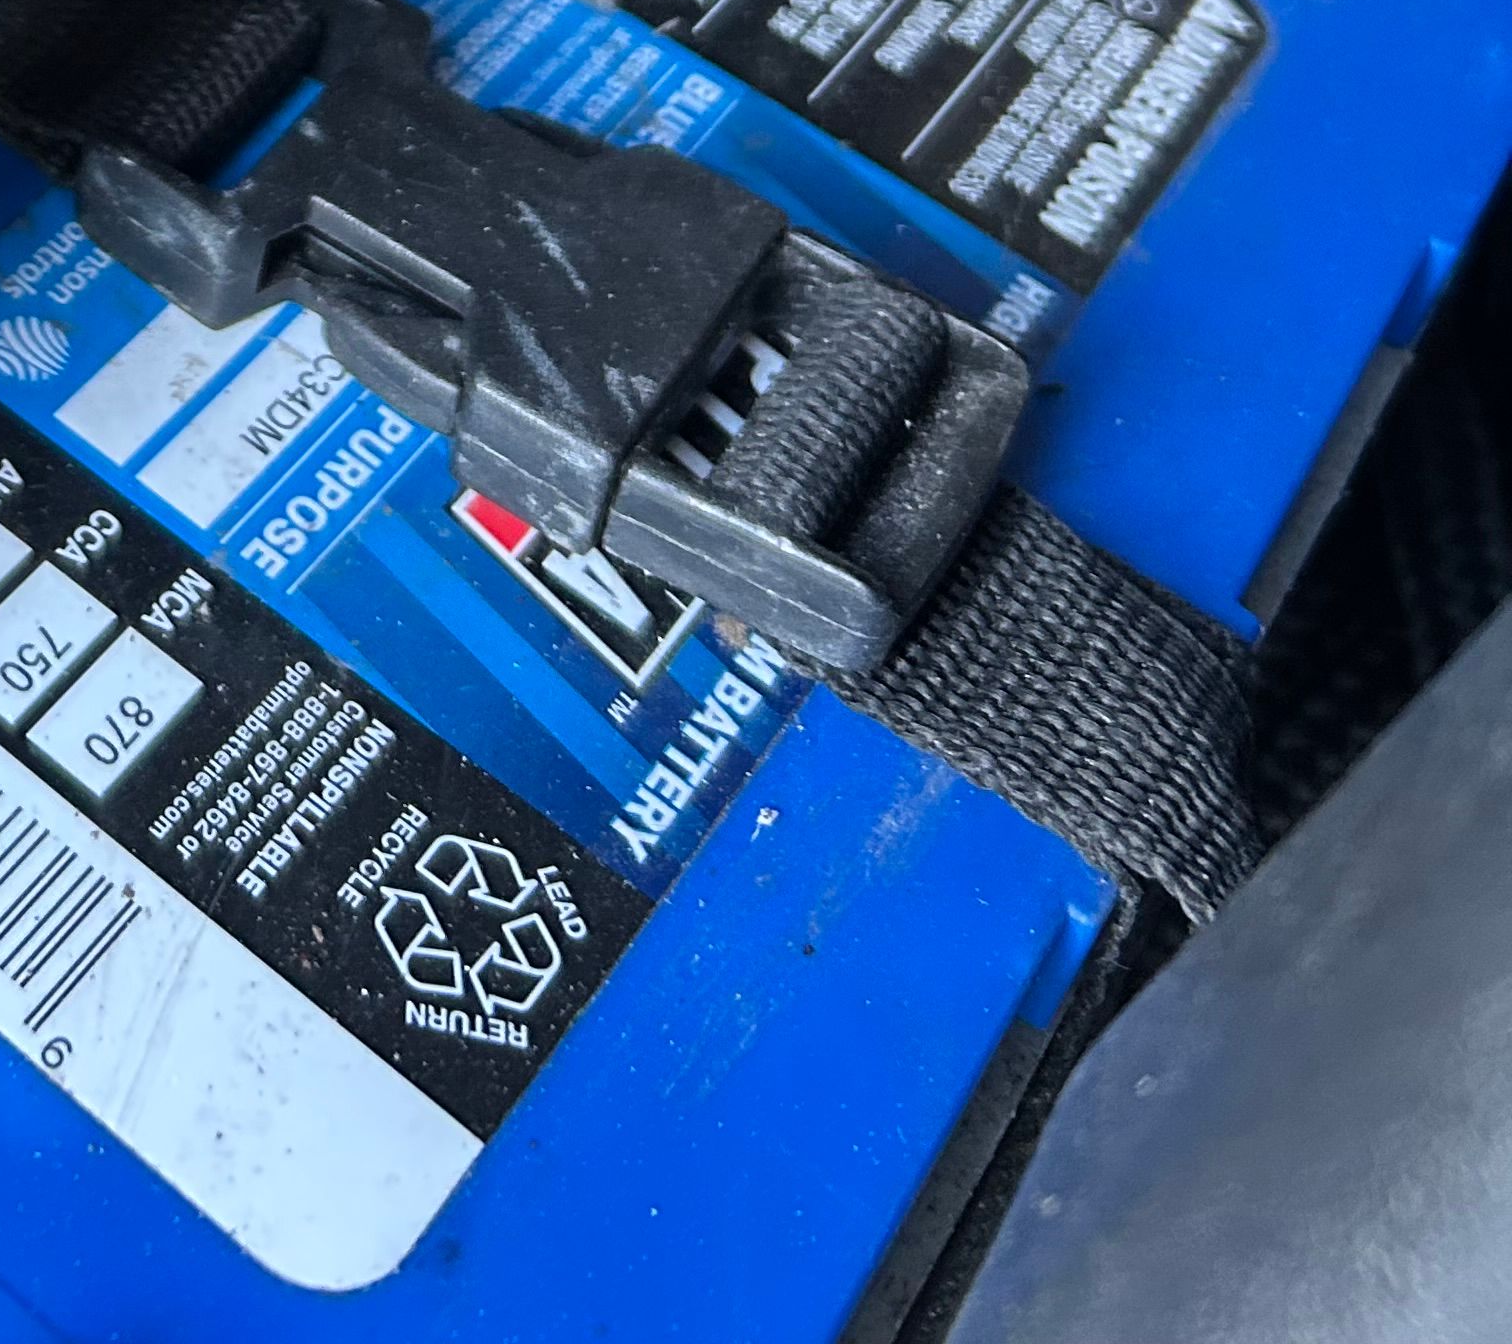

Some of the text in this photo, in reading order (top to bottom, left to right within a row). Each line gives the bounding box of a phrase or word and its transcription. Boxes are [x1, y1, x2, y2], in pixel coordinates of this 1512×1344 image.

[623, 69, 726, 156] BLUE
[44, 246, 113, 310] nson
[236, 400, 412, 584] PURPOSE
[55, 510, 121, 567] CCA
[141, 568, 213, 639] MCA
[0, 627, 73, 693] 750
[85, 697, 155, 766] 870
[149, 662, 313, 841] optimabatteries.com
[603, 668, 761, 864] BATTERY
[177, 683, 341, 862] 1-888-867-8462 or
[226, 701, 366, 854] Customer Service
[237, 719, 396, 899] NONSPILLABLE
[338, 805, 429, 910] RECYCLE
[537, 866, 588, 941] LEAD
[41, 1036, 73, 1070] 6
[406, 1001, 529, 1050] RETURN
